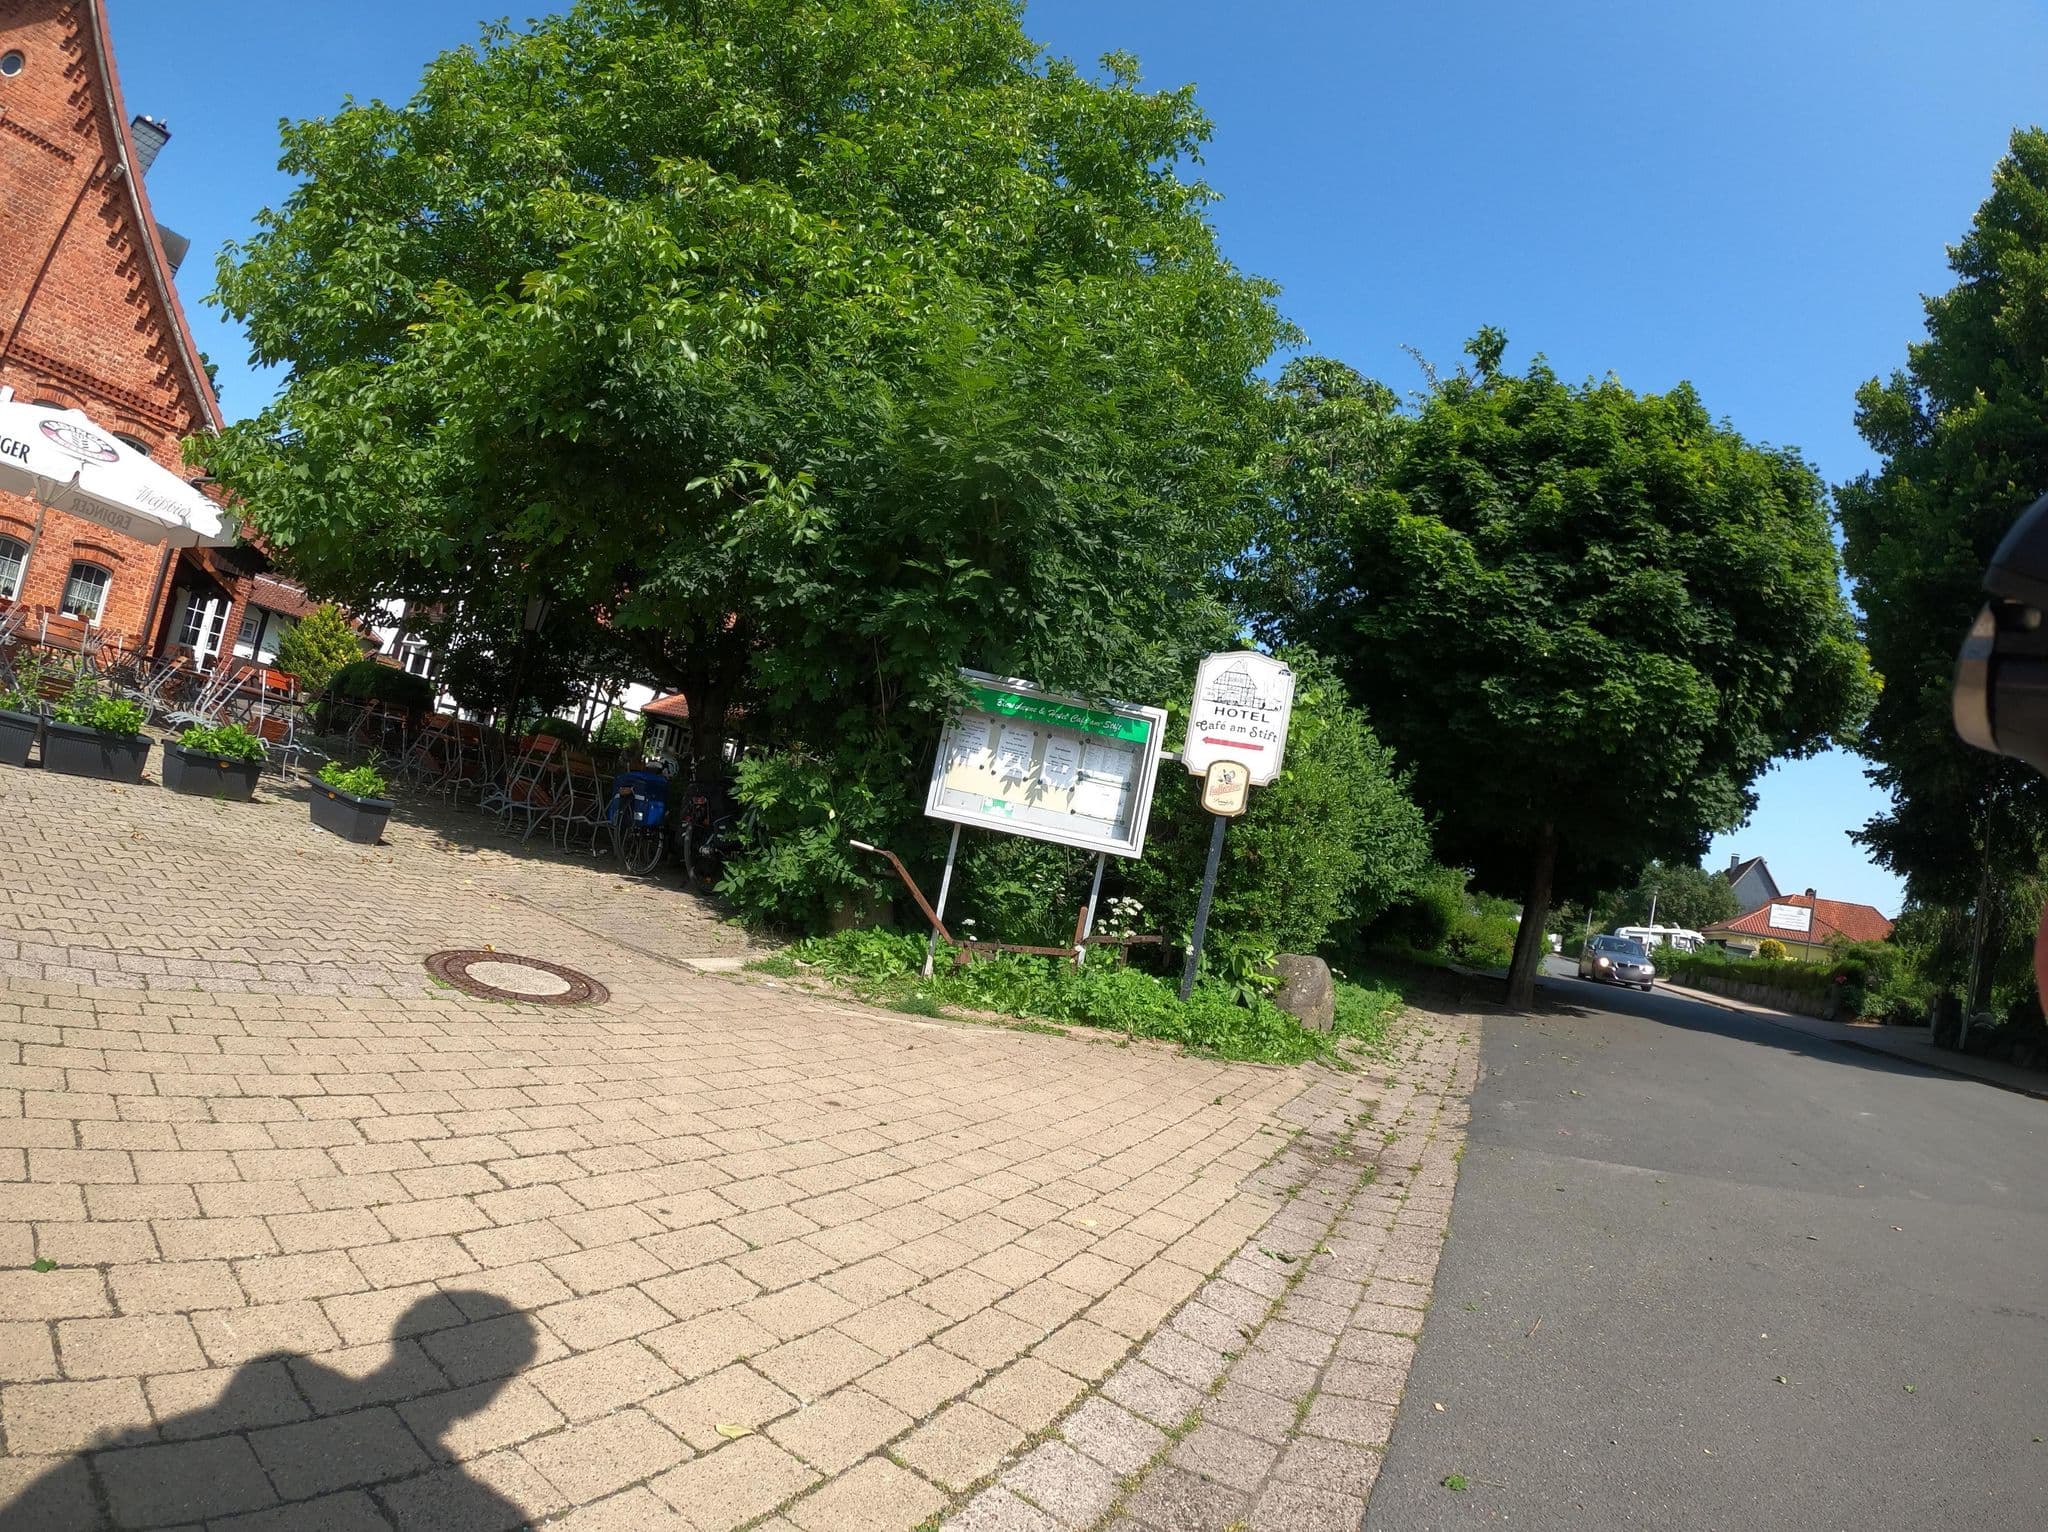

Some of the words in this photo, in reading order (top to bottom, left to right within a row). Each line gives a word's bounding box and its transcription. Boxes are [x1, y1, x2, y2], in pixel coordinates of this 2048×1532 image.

[0, 437, 30, 464] GER
[1214, 706, 1270, 724] HOTEL
[1195, 719, 1226, 732] Café
[1230, 724, 1247, 734] am
[1249, 726, 1277, 743] Stift
